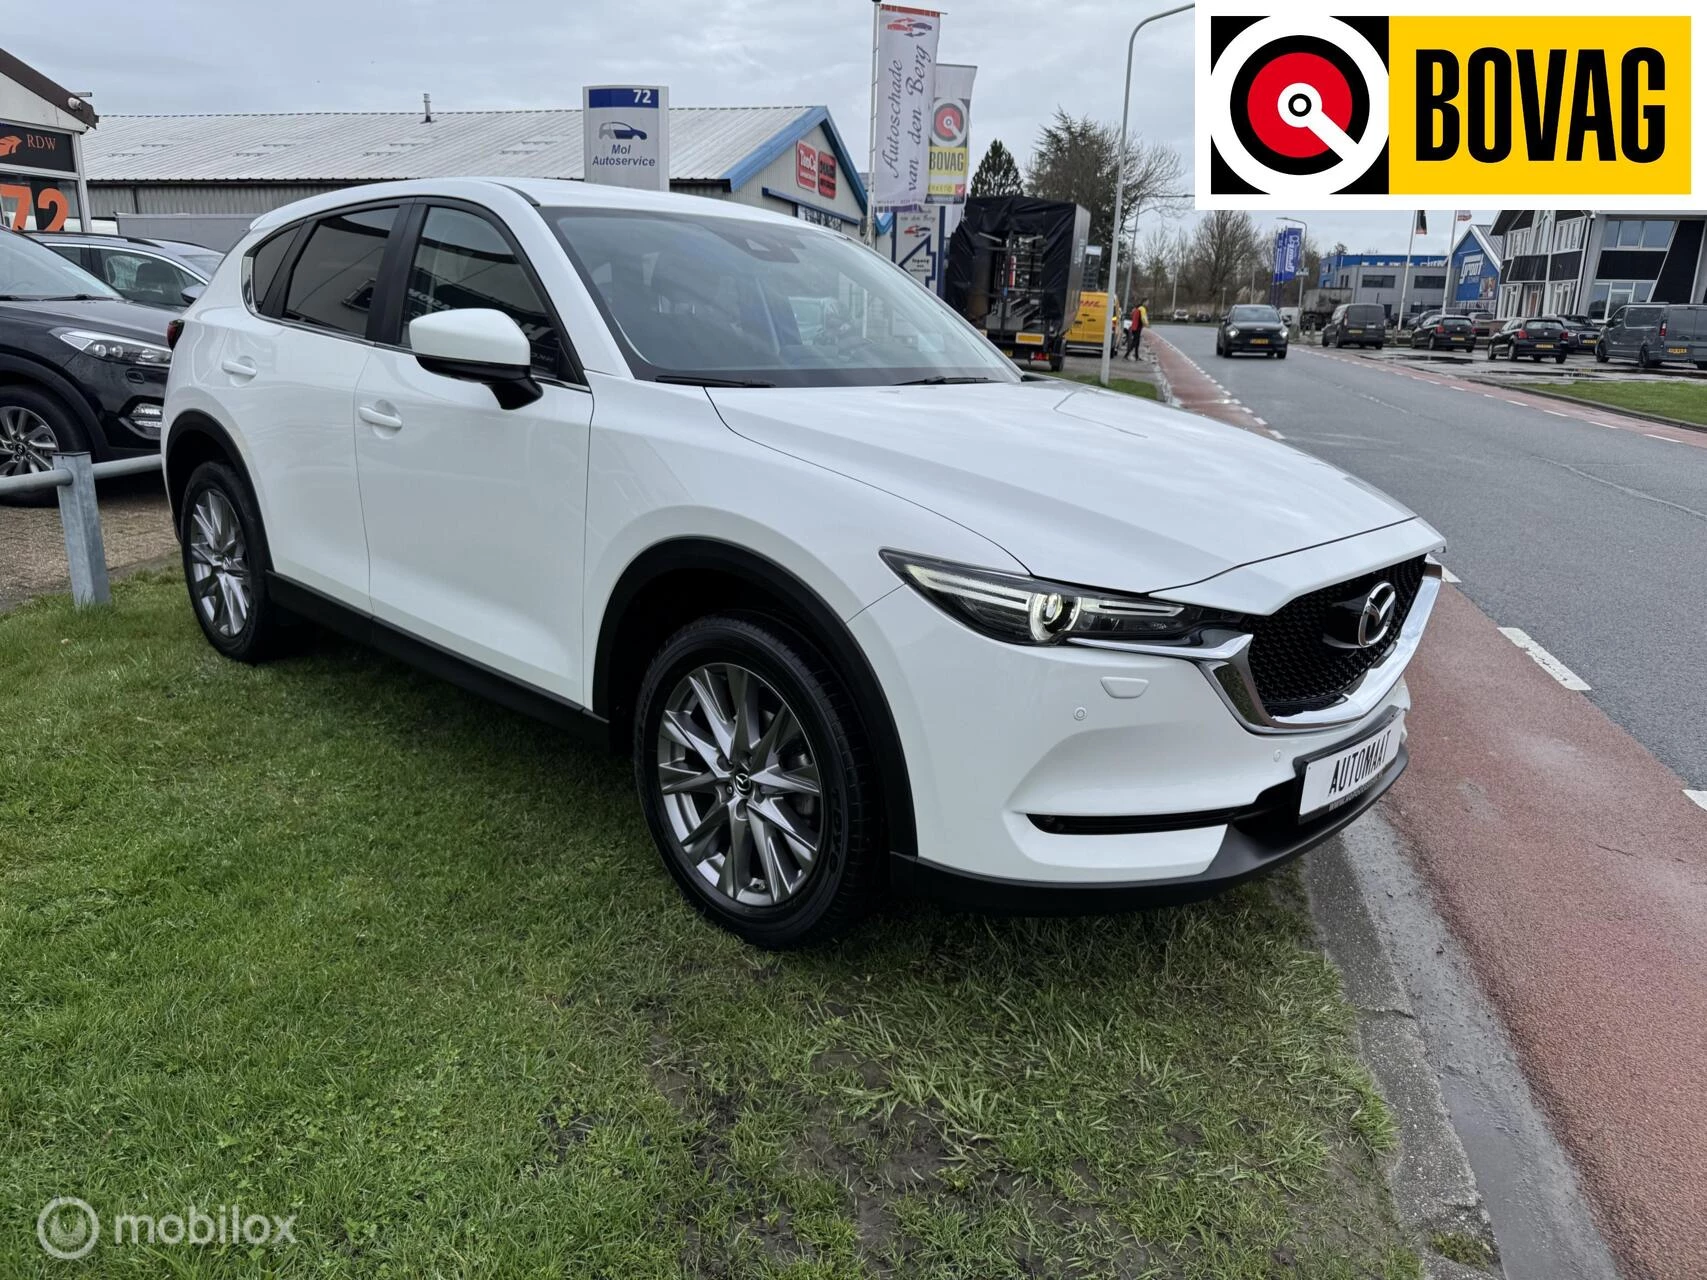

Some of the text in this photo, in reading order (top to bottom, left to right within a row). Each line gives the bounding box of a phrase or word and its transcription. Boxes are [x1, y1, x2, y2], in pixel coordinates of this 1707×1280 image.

[632, 89, 652, 104] 72
[882, 59, 903, 179] Autoschade
[905, 44, 932, 193] van den Berg
[26, 133, 56, 151] RDW
[611, 143, 632, 155] Mol
[592, 154, 656, 167] Autoservice
[929, 151, 965, 172] BOVAG
[0, 183, 69, 231] 72
[1328, 729, 1392, 797] AUTOMAAT
